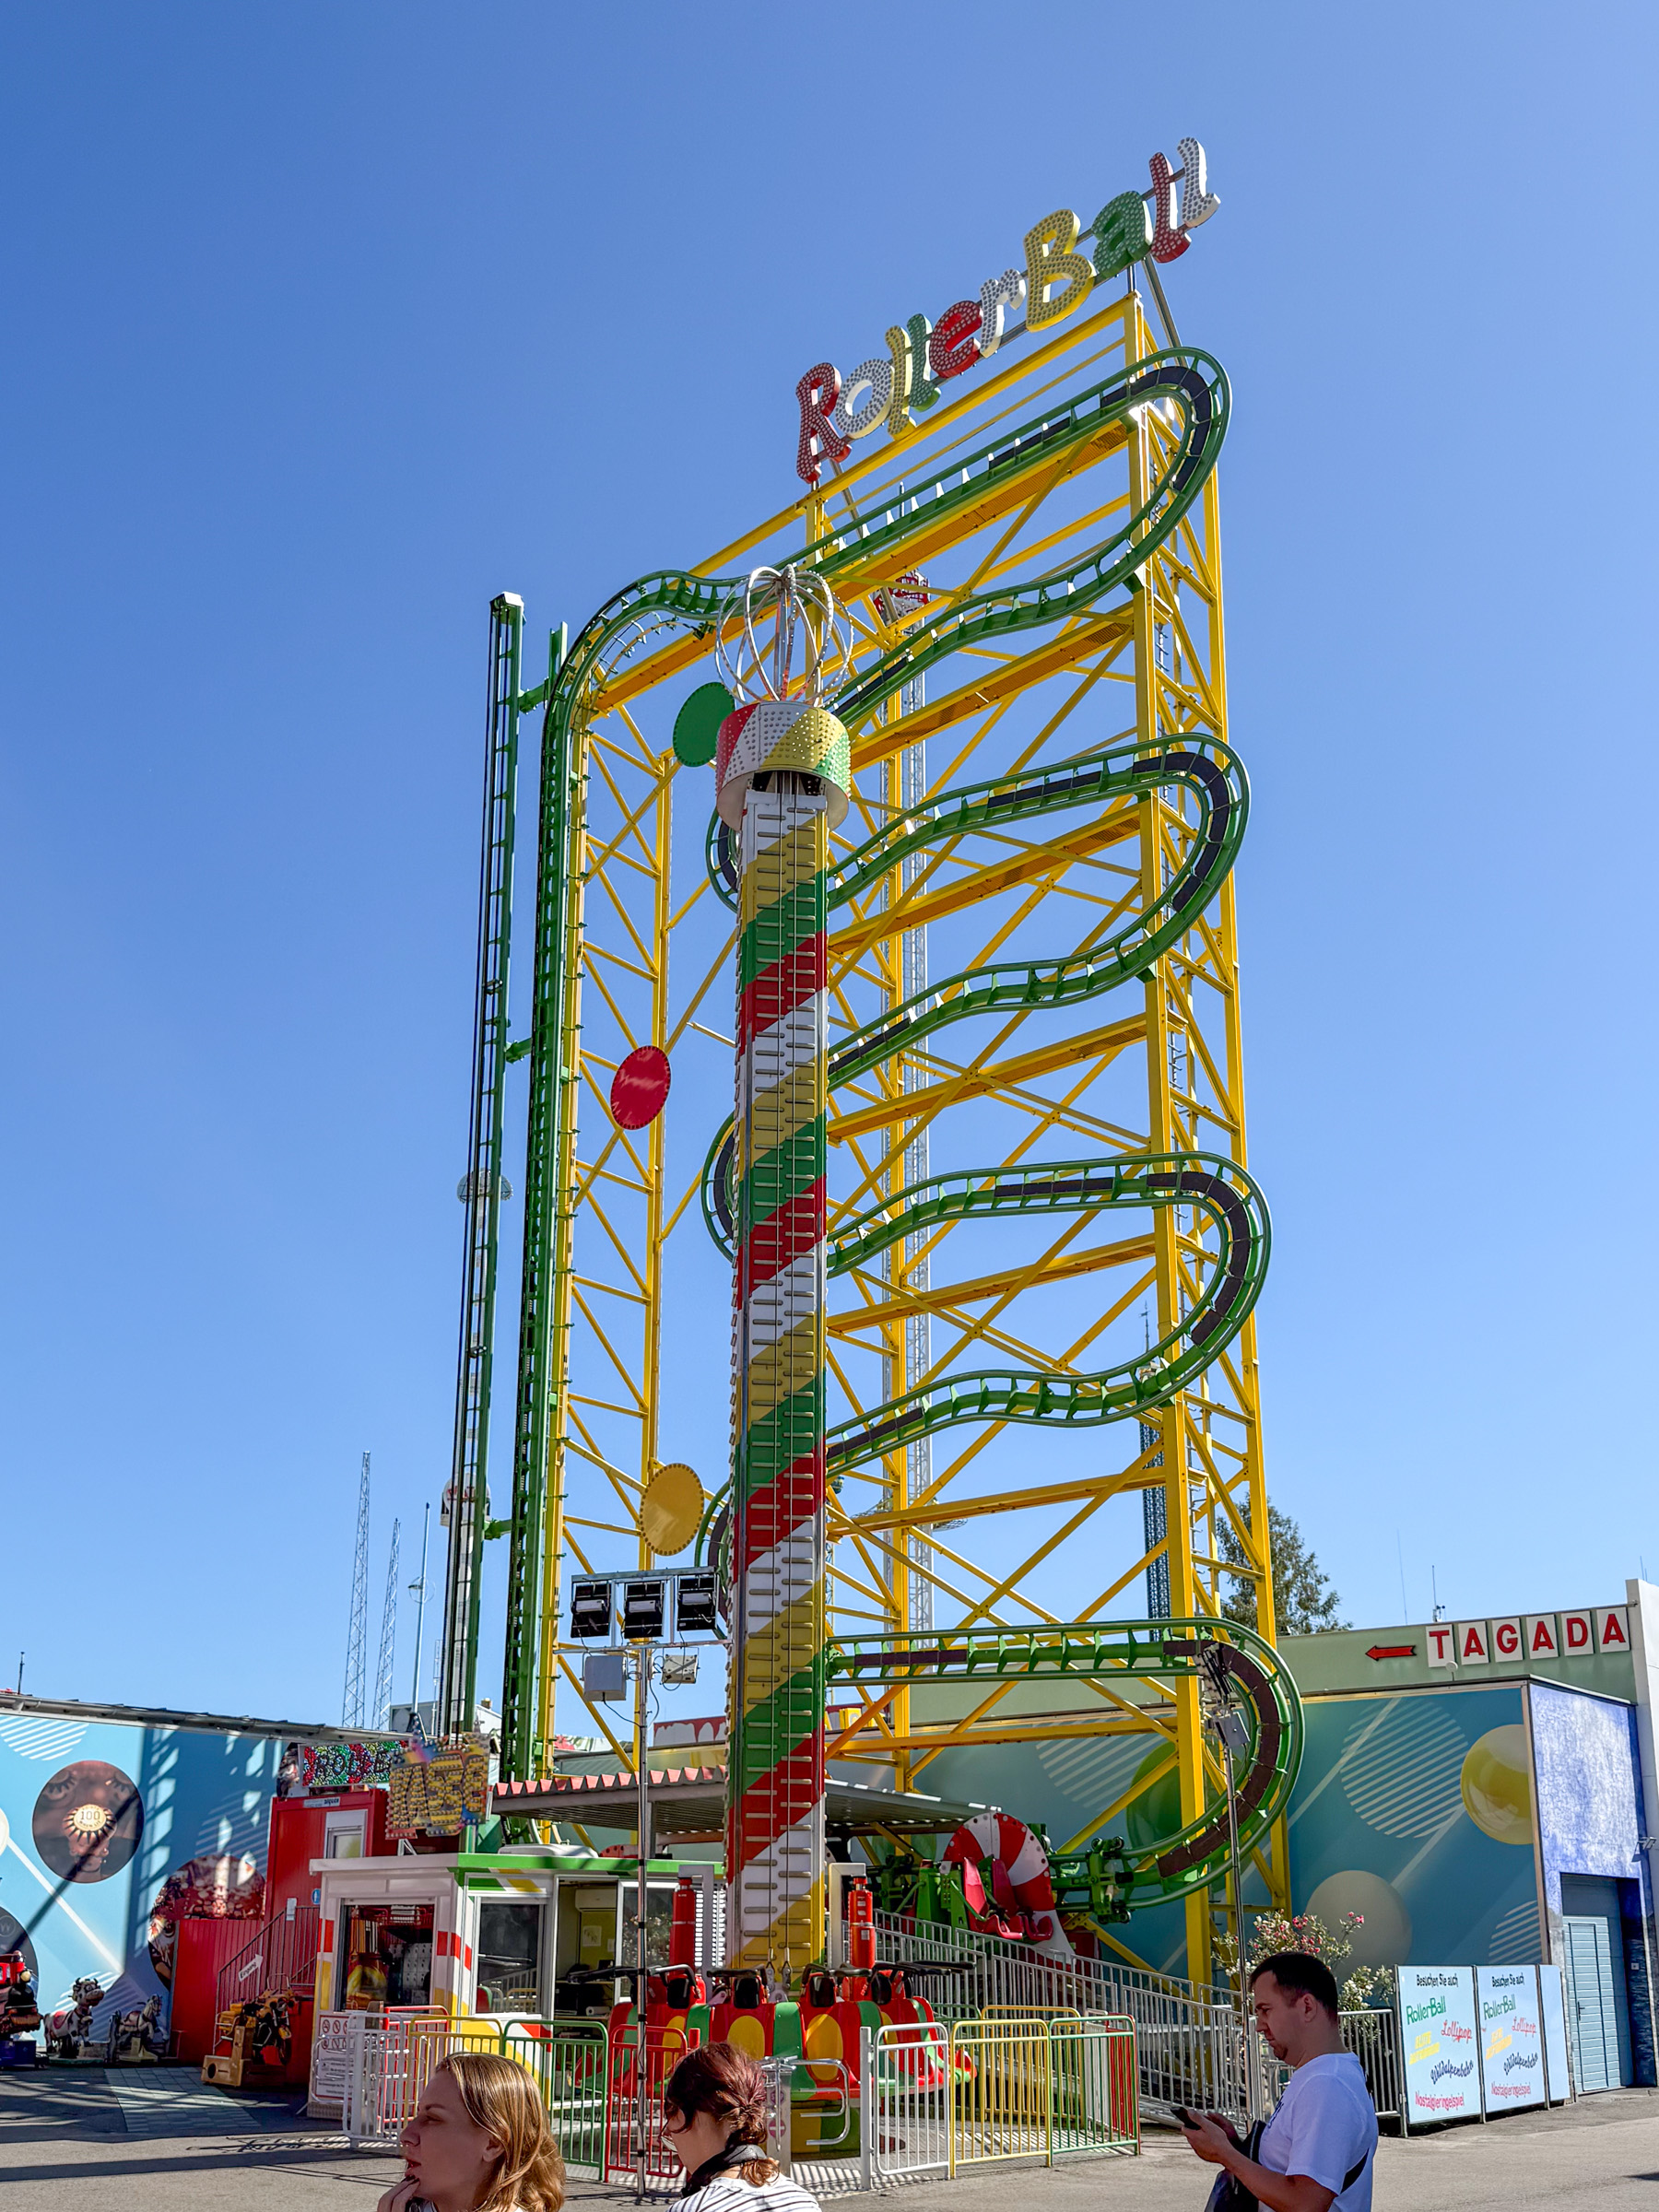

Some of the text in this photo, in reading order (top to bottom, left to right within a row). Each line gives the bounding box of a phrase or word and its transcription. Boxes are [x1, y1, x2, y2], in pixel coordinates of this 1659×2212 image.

[796, 136, 1220, 484] RollerBall
[1429, 1613, 1627, 1659] TAGADA
[81, 1810, 100, 1820] 100
[1417, 1972, 1459, 1987] Besuchen Sie auch
[1406, 1995, 1447, 2025] RollerBall
[1483, 1994, 1516, 2020] RollerBall
[1441, 2019, 1473, 2043] Lollipop
